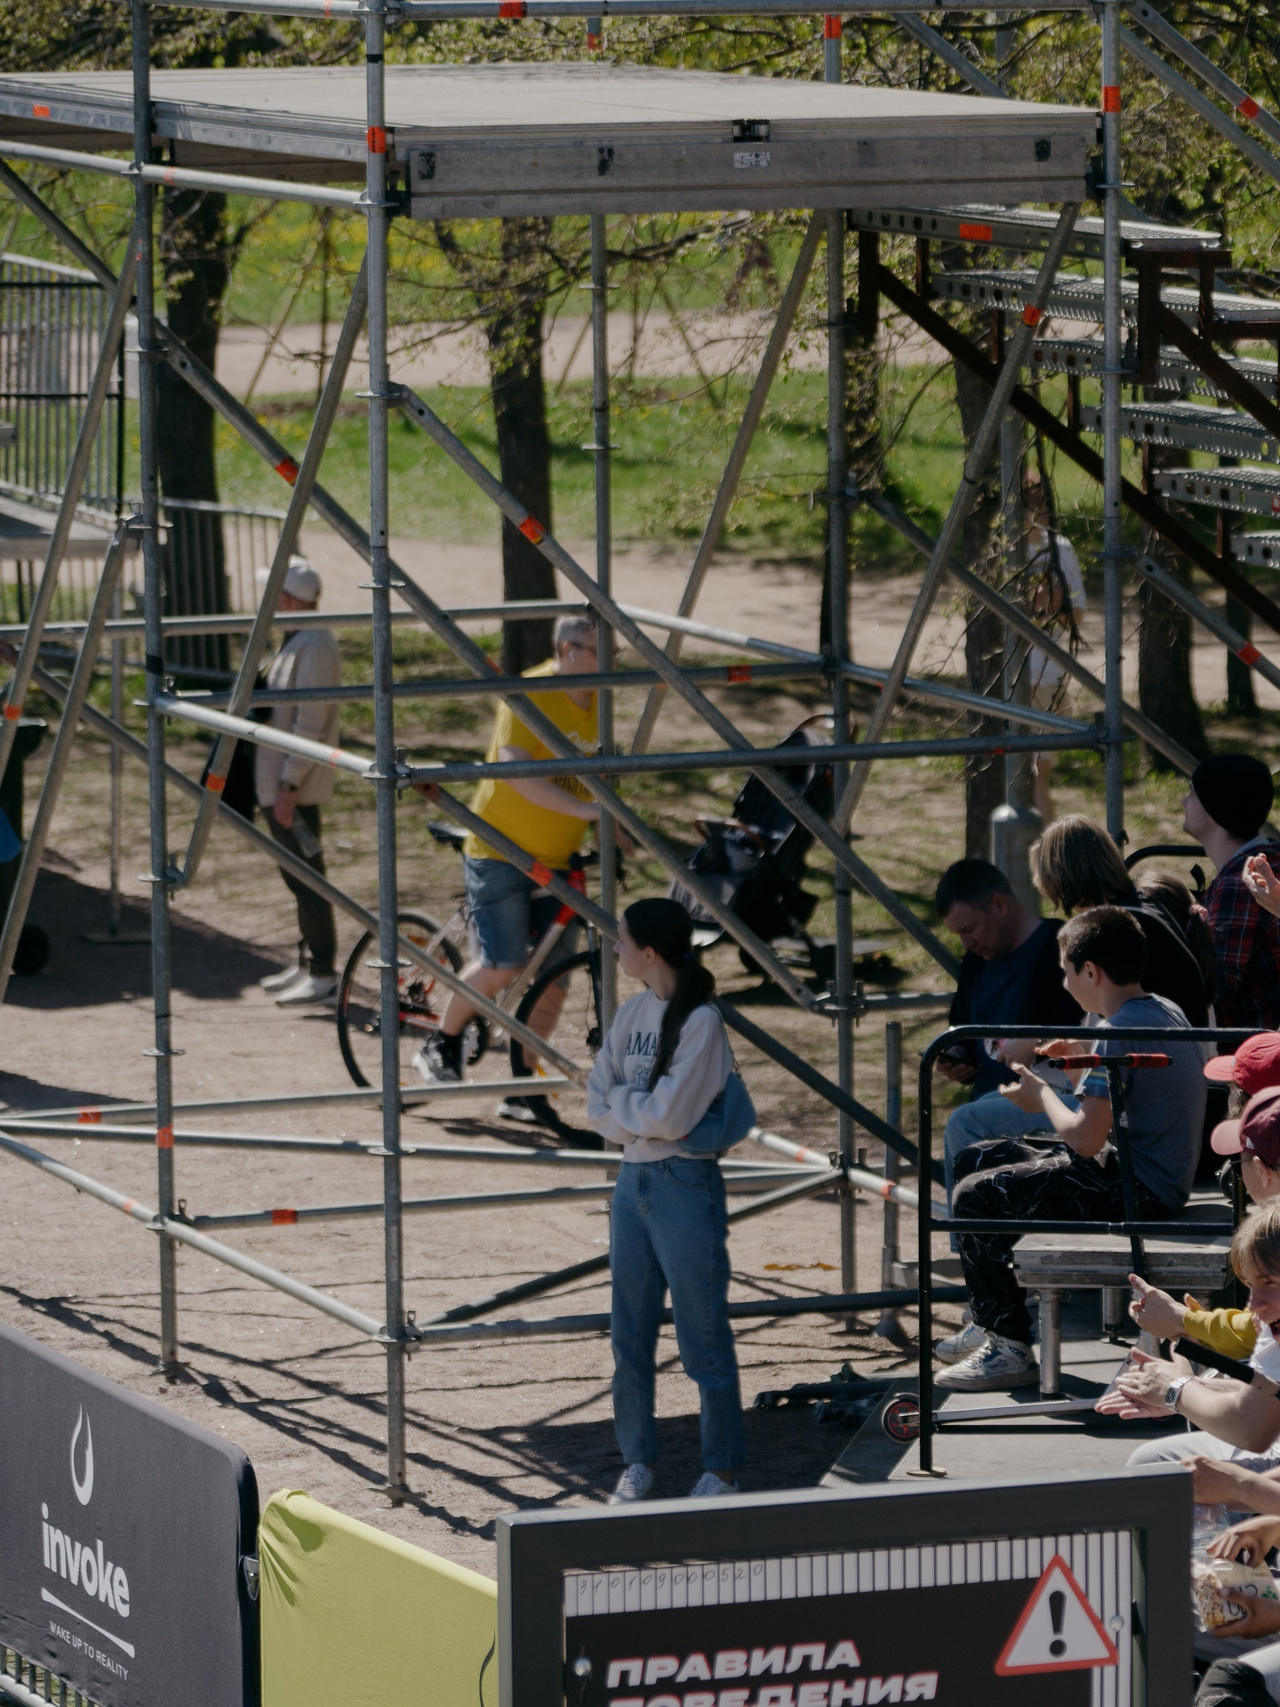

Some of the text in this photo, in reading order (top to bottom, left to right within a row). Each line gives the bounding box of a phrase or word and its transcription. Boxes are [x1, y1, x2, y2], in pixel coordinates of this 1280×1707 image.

[41, 1502, 130, 1618] invoke
[49, 1620, 128, 1680] WAKE UP TO REALITY
[606, 1639, 862, 1689] ПРАВИЛА
